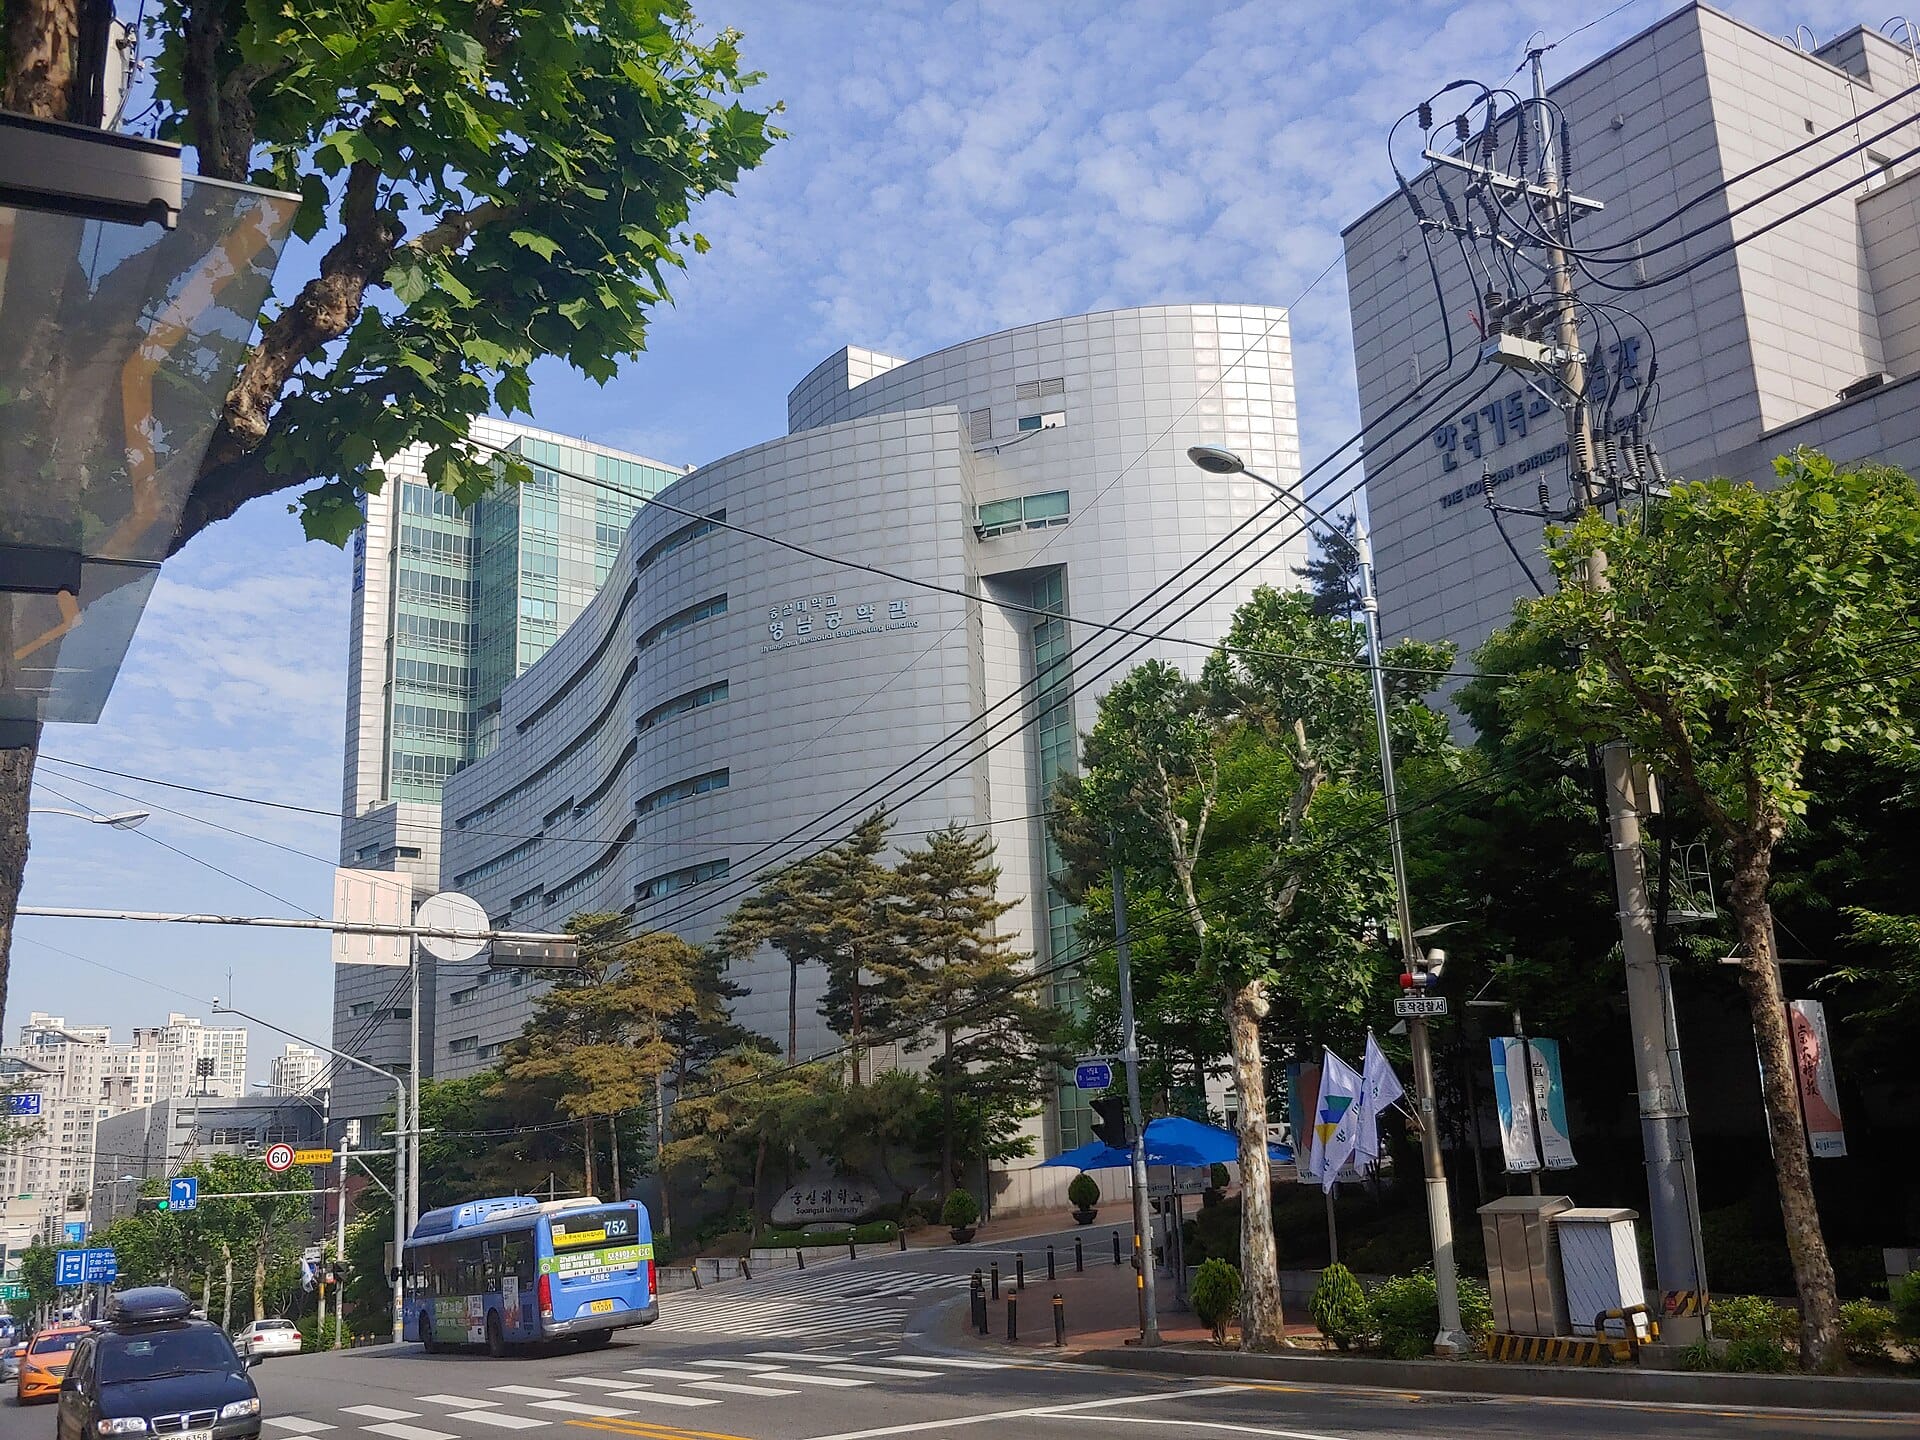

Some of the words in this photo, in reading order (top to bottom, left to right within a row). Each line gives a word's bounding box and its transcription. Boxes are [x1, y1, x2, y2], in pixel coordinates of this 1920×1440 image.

[1440, 489, 1464, 508] THE
[1466, 467, 1515, 499] KOEAN
[1517, 443, 1569, 476] CHRISTI
[769, 594, 838, 619] 숭실대학교
[769, 600, 909, 641] 형남공학관
[1398, 1000, 1444, 1012] 동작경찰서
[272, 1151, 288, 1163] 60
[171, 1199, 194, 1209] 비보호
[605, 1220, 627, 1235] 752
